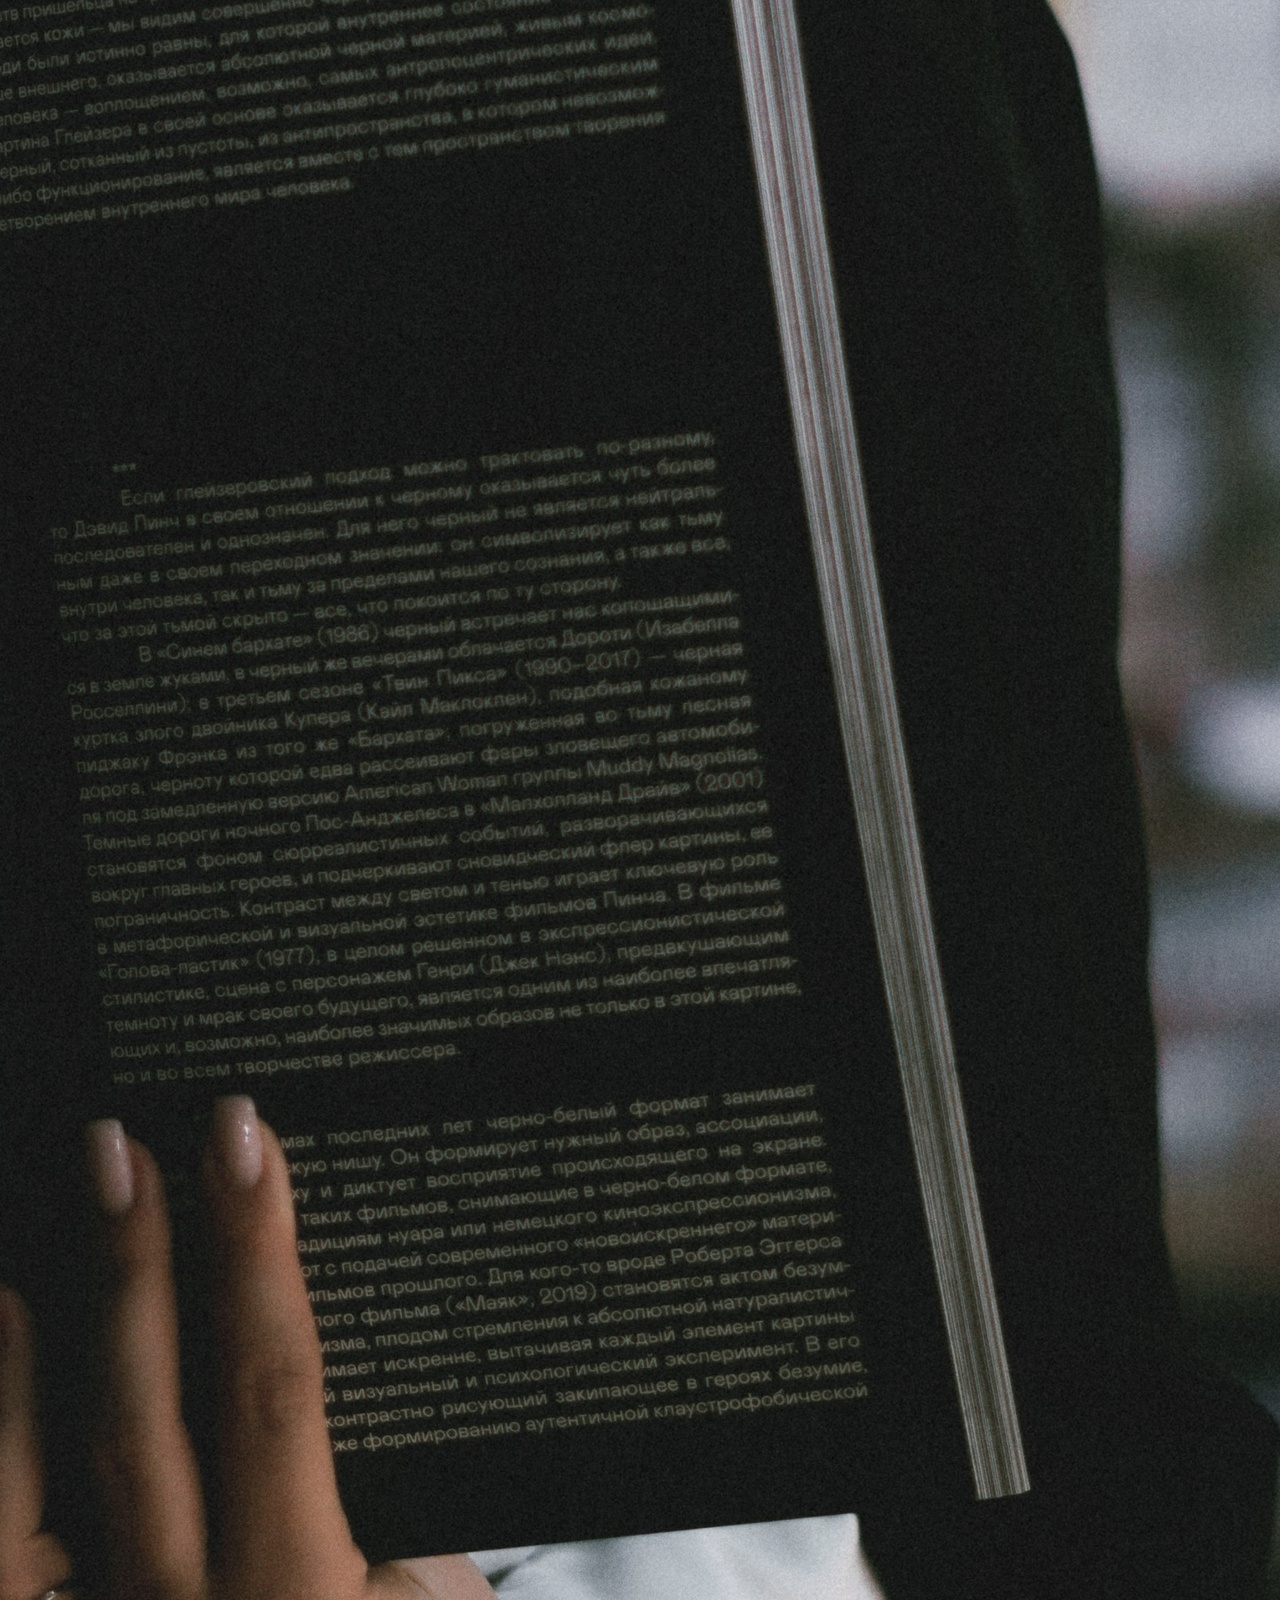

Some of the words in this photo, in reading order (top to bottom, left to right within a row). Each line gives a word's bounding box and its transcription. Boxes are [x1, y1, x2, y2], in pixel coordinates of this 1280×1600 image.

[120, 488, 165, 507] Если
[139, 645, 151, 663] В
[562, 604, 597, 621] нас
[83, 811, 102, 826] ля
[106, 808, 138, 824] под
[464, 803, 475, 817] в
[473, 881, 485, 895] и
[731, 851, 779, 872] роль
[326, 948, 337, 962] в
[520, 930, 531, 944] в
[275, 979, 285, 993] с
[114, 1070, 135, 1085] но
[140, 1069, 151, 1082] и
[156, 1067, 178, 1081] во
[183, 1063, 230, 1079] всем
[328, 1123, 429, 1145] последних
[443, 1119, 472, 1135] лет
[487, 1100, 617, 1132] черно-белый
[629, 1095, 708, 1119] формат
[723, 1083, 815, 1106] занимает
[333, 1154, 385, 1172] нишу.
[390, 1147, 420, 1166] Он
[425, 1138, 537, 1165] формирует
[544, 1126, 621, 1153] нужный
[627, 1123, 690, 1143] образ,
[696, 1109, 823, 1135] ассоциации,
[301, 1209, 351, 1227] таких
[357, 1199, 453, 1224] фильмов,
[458, 1186, 579, 1211] снимающие
[583, 1184, 594, 1198] в
[600, 1170, 730, 1197] черно-белом
[735, 1159, 832, 1185] формате,
[321, 1185, 332, 1199] и
[342, 1177, 415, 1199] диктует
[427, 1164, 541, 1188] восприятие
[553, 1147, 708, 1178] происходящего
[718, 1143, 742, 1158] на
[753, 1134, 827, 1155] экране.
[325, 1262, 336, 1276] с
[342, 1249, 422, 1274] подачей
[427, 1238, 569, 1266] современного
[575, 1219, 756, 1249] «новоискреннего»
[762, 1209, 842, 1230] матери-
[388, 1225, 445, 1246] нуара
[451, 1221, 486, 1238] или
[492, 1210, 598, 1233] немецкого
[603, 1184, 837, 1222] киноэкспрессионизма,
[360, 1302, 441, 1327] фильма
[445, 1294, 535, 1318] («Маяк»,
[539, 1281, 597, 1305] 2019)
[602, 1273, 713, 1298] становятся
[719, 1267, 778, 1286] актом
[782, 1260, 850, 1279] безум-
[381, 1273, 482, 1298] прошлого.
[487, 1266, 524, 1287] Для
[530, 1260, 601, 1280] кого-то
[606, 1253, 666, 1275] вроде
[670, 1244, 754, 1265] Роберта
[760, 1234, 842, 1256] Эггерса
[375, 1327, 448, 1348] плодом
[452, 1314, 568, 1341] стремления
[573, 1313, 581, 1327] к
[588, 1296, 707, 1325] абсолютной
[712, 1285, 855, 1312] натуралистич-
[384, 1350, 480, 1372] искренне,
[487, 1337, 592, 1361] вытачивая
[599, 1324, 676, 1349] каждый
[683, 1319, 764, 1340] элемент
[772, 1309, 854, 1332] картины
[342, 1373, 458, 1402] визуальный
[465, 1375, 477, 1389] и
[484, 1351, 658, 1387] психологический
[666, 1341, 798, 1367] эксперимент.
[805, 1334, 820, 1353] В
[827, 1334, 860, 1350] его
[442, 1388, 548, 1420] рисующий
[557, 1378, 679, 1404] закипающее
[686, 1376, 697, 1390] в
[705, 1369, 771, 1390] героях
[778, 1359, 868, 1381] безумие,
[332, 1437, 358, 1453] же
[363, 1420, 521, 1452] формированию
[526, 1402, 649, 1434] аутентичной
[654, 1380, 868, 1419] клаустрофобической
